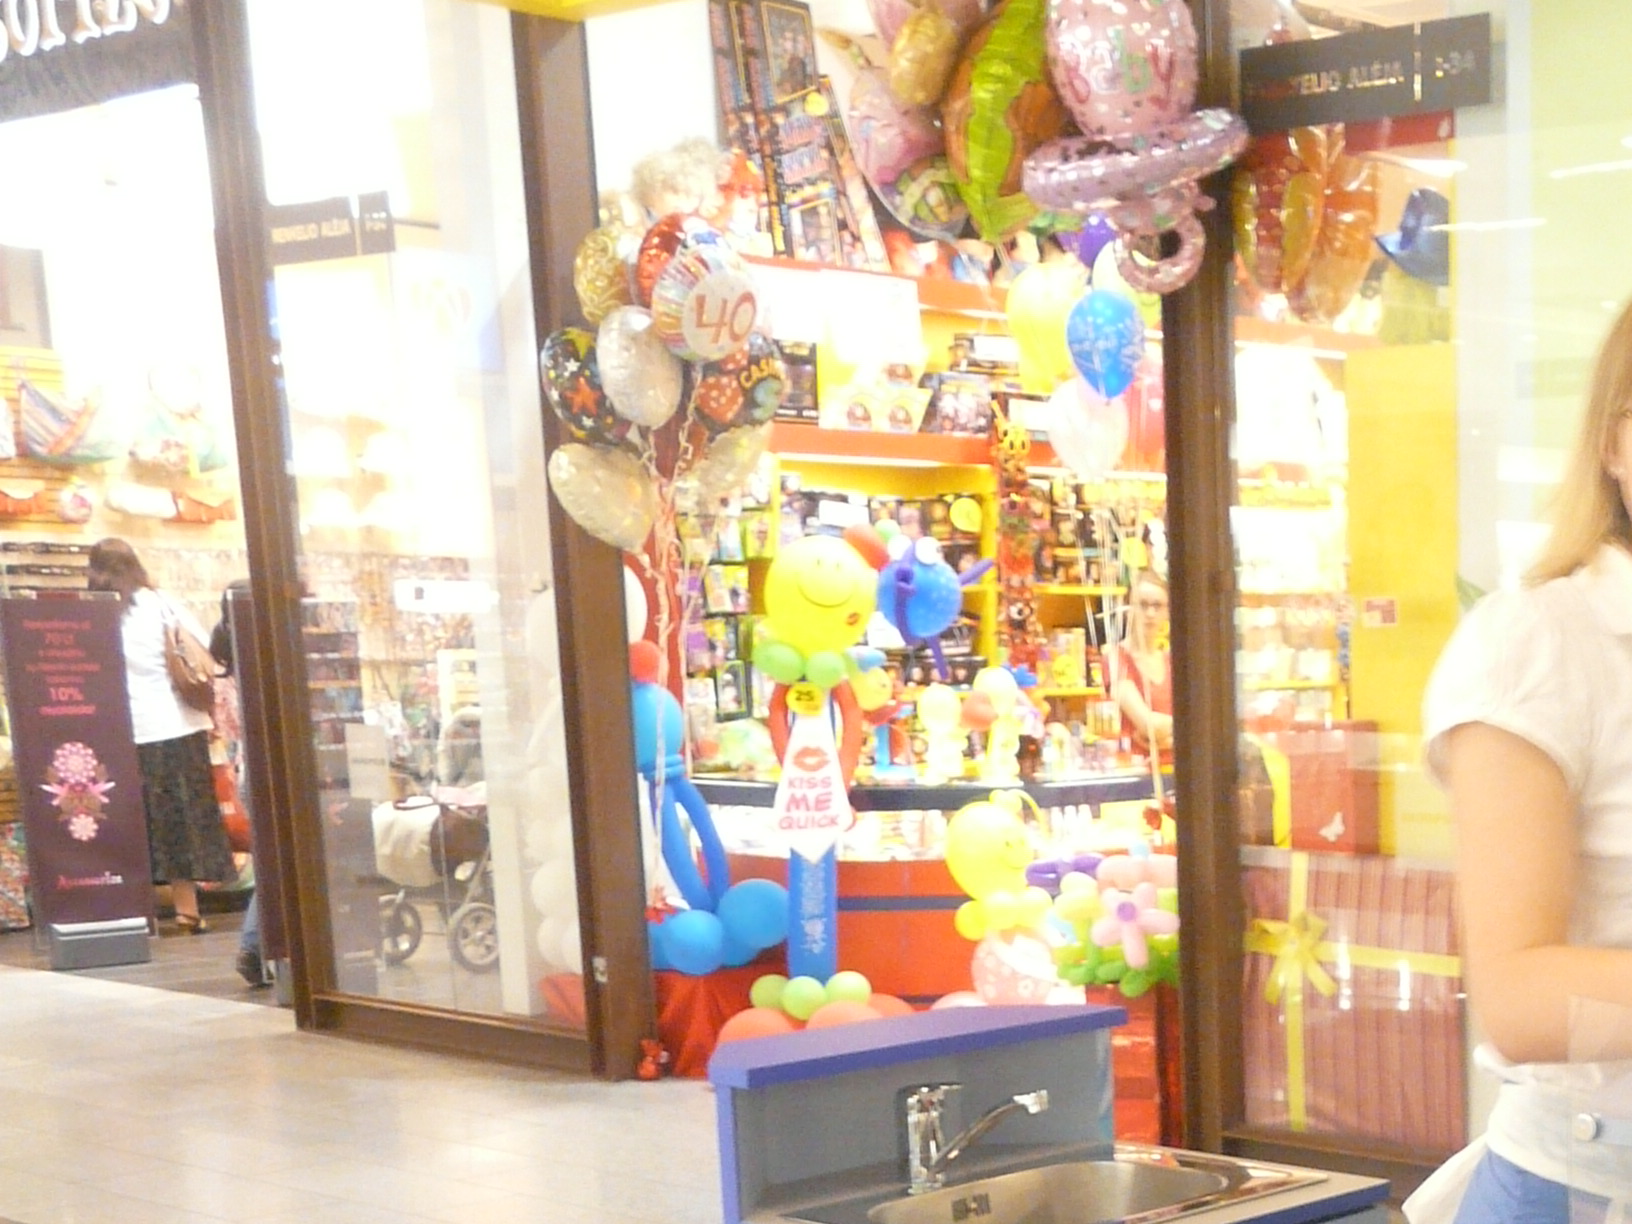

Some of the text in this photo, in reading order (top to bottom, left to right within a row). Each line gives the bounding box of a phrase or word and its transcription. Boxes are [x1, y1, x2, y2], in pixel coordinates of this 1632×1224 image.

[694, 291, 757, 344] 40
[787, 776, 832, 790] KISS
[786, 791, 833, 814] ME
[778, 814, 840, 831] QUICK
